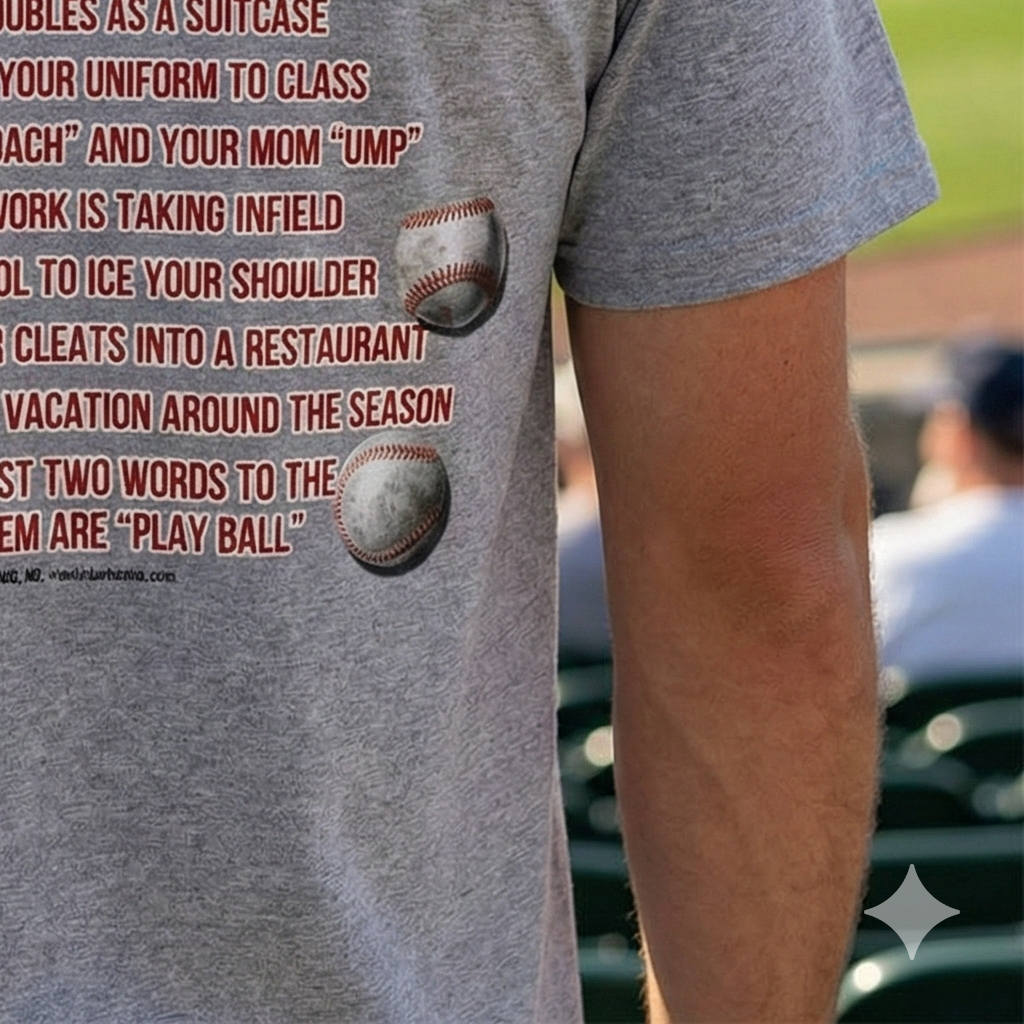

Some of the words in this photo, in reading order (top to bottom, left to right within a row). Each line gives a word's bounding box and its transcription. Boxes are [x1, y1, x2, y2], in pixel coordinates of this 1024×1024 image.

[84, 60, 219, 99] UNIFORM
[230, 61, 267, 100] TO
[276, 61, 368, 101] CLASS
[88, 126, 151, 165] AND
[160, 127, 240, 167] YOUR
[248, 128, 321, 167] MOM
[330, 128, 422, 166] “UMP”
[78, 192, 107, 230] IS
[118, 192, 225, 233] TAKING
[235, 193, 344, 233] INFIELD
[41, 258, 77, 295] TO
[87, 258, 135, 297] ICE
[145, 259, 223, 299] YOUR
[231, 258, 378, 300] SHOULDER
[13, 324, 126, 364] CLEATS
[135, 326, 205, 366] INTO
[214, 331, 234, 364] A
[244, 324, 426, 367] RESTAURANT
[4, 391, 152, 430] VACATION
[162, 395, 280, 434] AROUND
[292, 389, 342, 433] THE
[348, 387, 453, 428] SEASON
[44, 458, 111, 496] TWO
[120, 459, 227, 501] WORDS
[237, 462, 275, 501] TO
[286, 460, 335, 500] THE
[50, 512, 109, 550] ARE
[118, 512, 206, 552] “PLAY
[217, 515, 306, 555] BALL”
